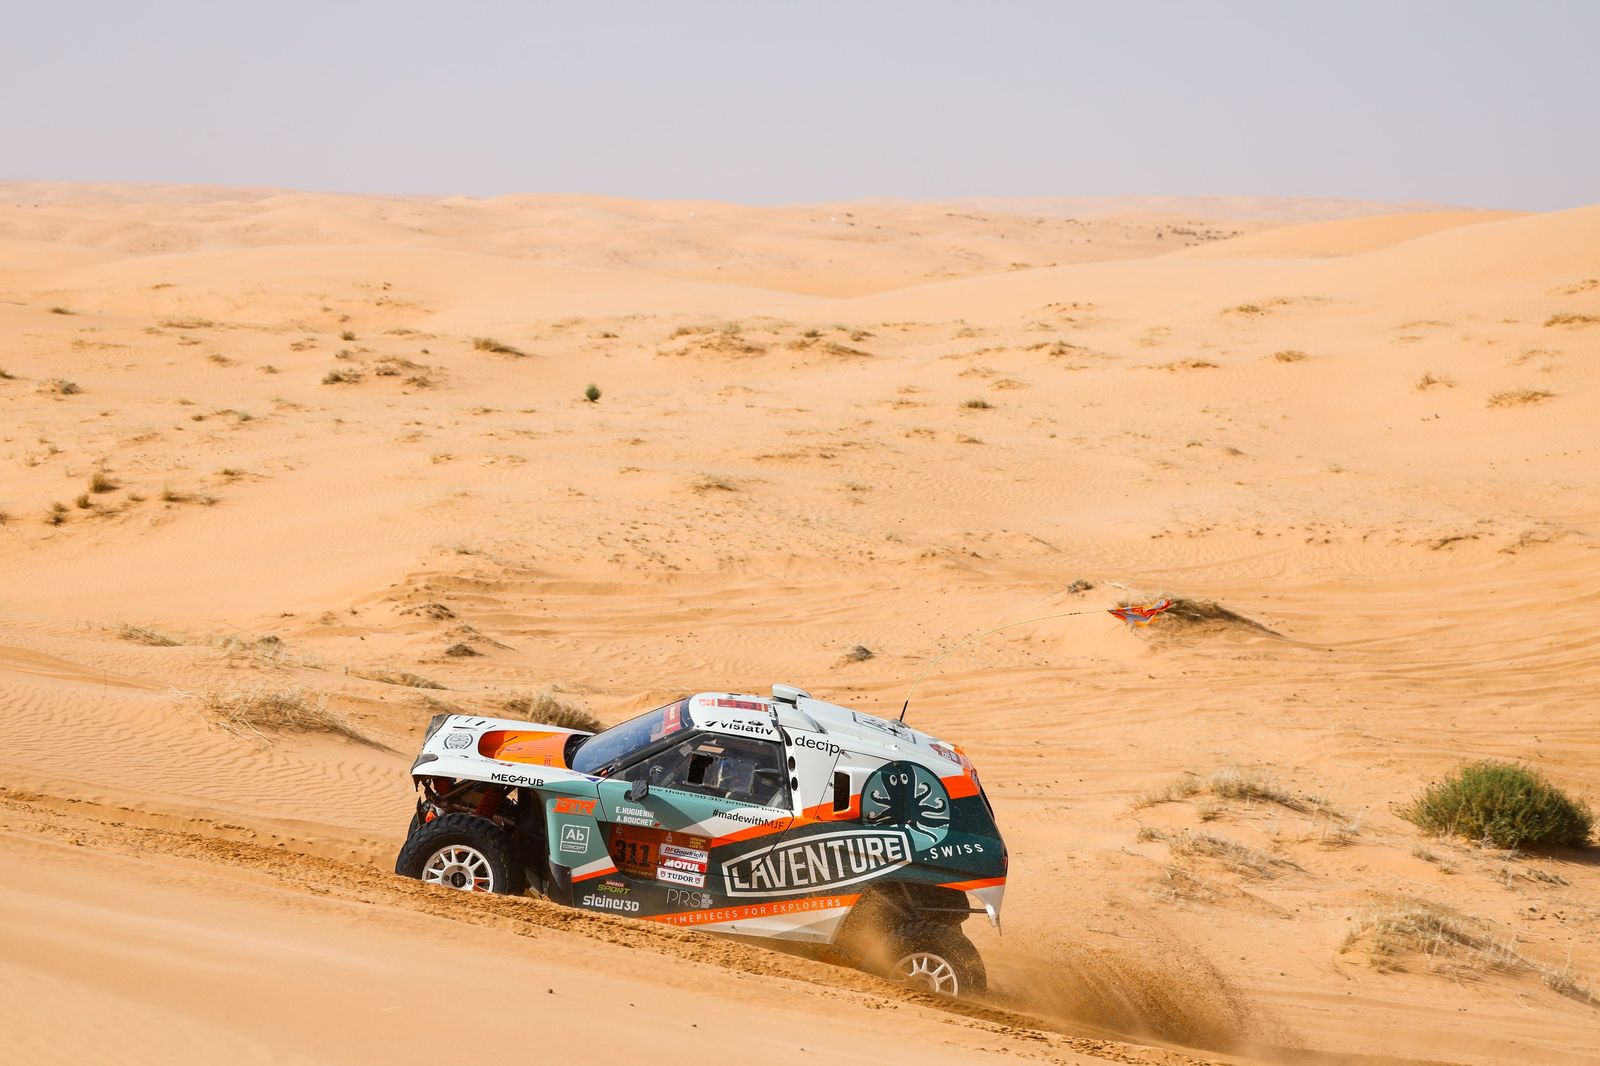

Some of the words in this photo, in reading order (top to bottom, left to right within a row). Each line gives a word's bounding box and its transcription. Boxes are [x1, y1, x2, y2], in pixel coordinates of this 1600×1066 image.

[721, 722, 774, 735] visiativ
[795, 735, 840, 757] decip
[712, 808, 785, 830] #madewithMJF
[566, 829, 585, 841] Ab
[562, 843, 585, 851] CONCEPT
[615, 839, 651, 868] 311
[664, 847, 704, 859] BFGoodrich
[664, 859, 700, 872] MOTUL
[667, 872, 694, 883] TUDOR
[597, 884, 631, 895] SPORT
[582, 893, 640, 912] steiner3D
[666, 888, 701, 908] PRS
[666, 909, 737, 924] TIMEPIECES
[744, 903, 767, 916] FOR
[773, 899, 841, 913] EXPLORERS
